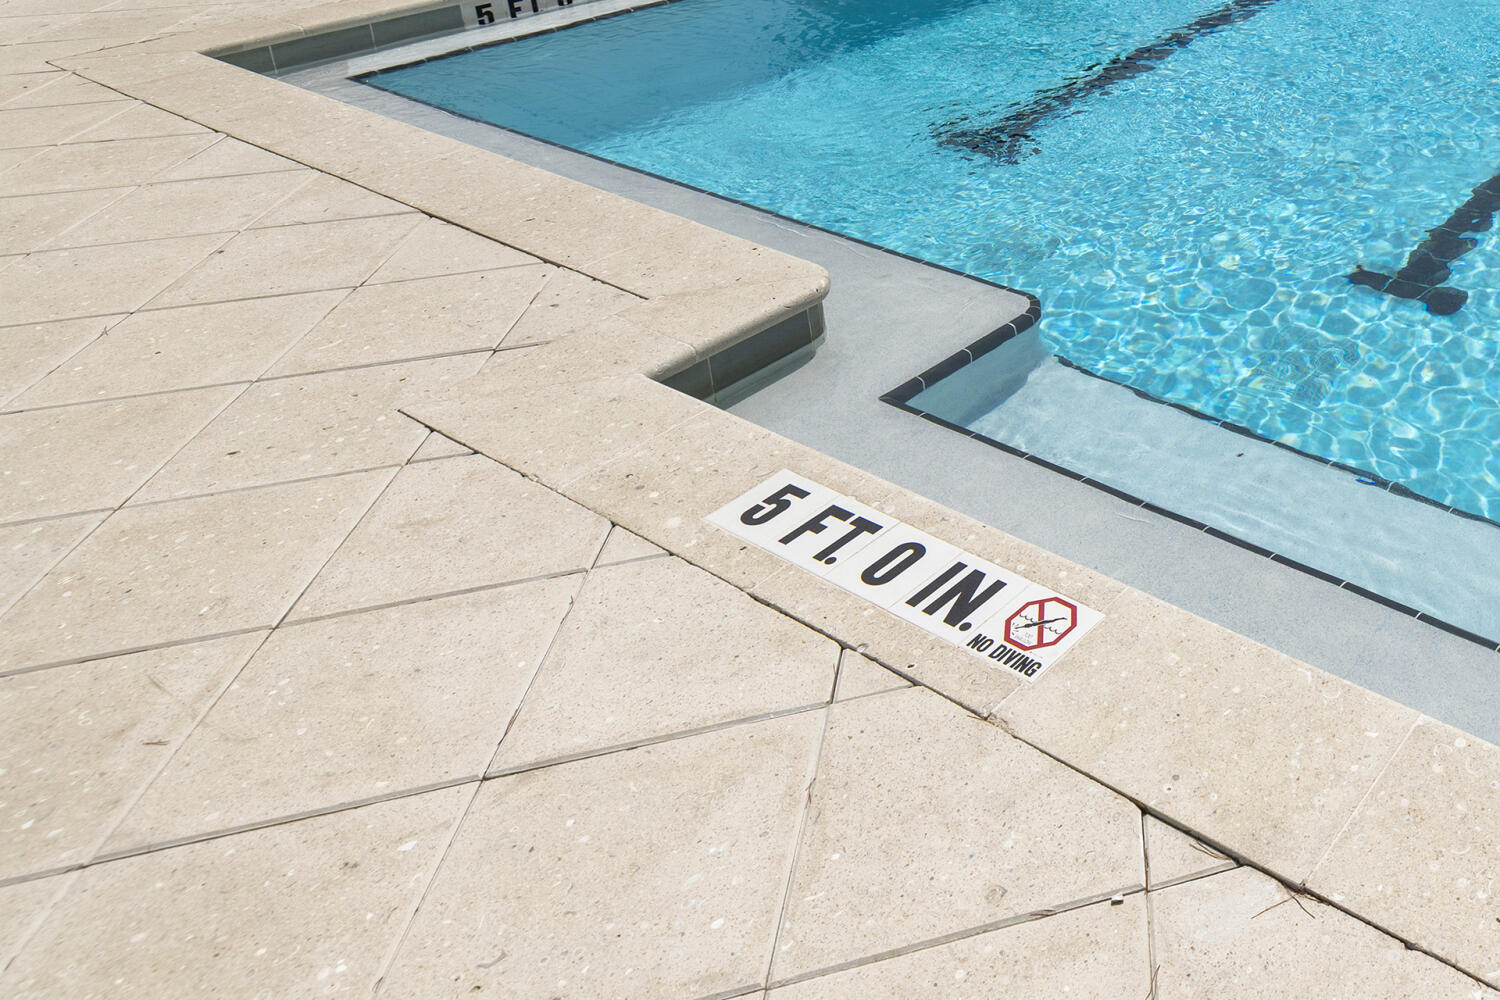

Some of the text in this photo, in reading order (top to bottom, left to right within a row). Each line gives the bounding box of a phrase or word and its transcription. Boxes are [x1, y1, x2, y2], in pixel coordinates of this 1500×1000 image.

[475, 3, 495, 25] 5
[740, 483, 811, 526] 5
[778, 504, 884, 566] FT.
[905, 561, 1007, 632] IN.
[966, 633, 993, 657] NO
[990, 643, 1042, 678] DIVING
